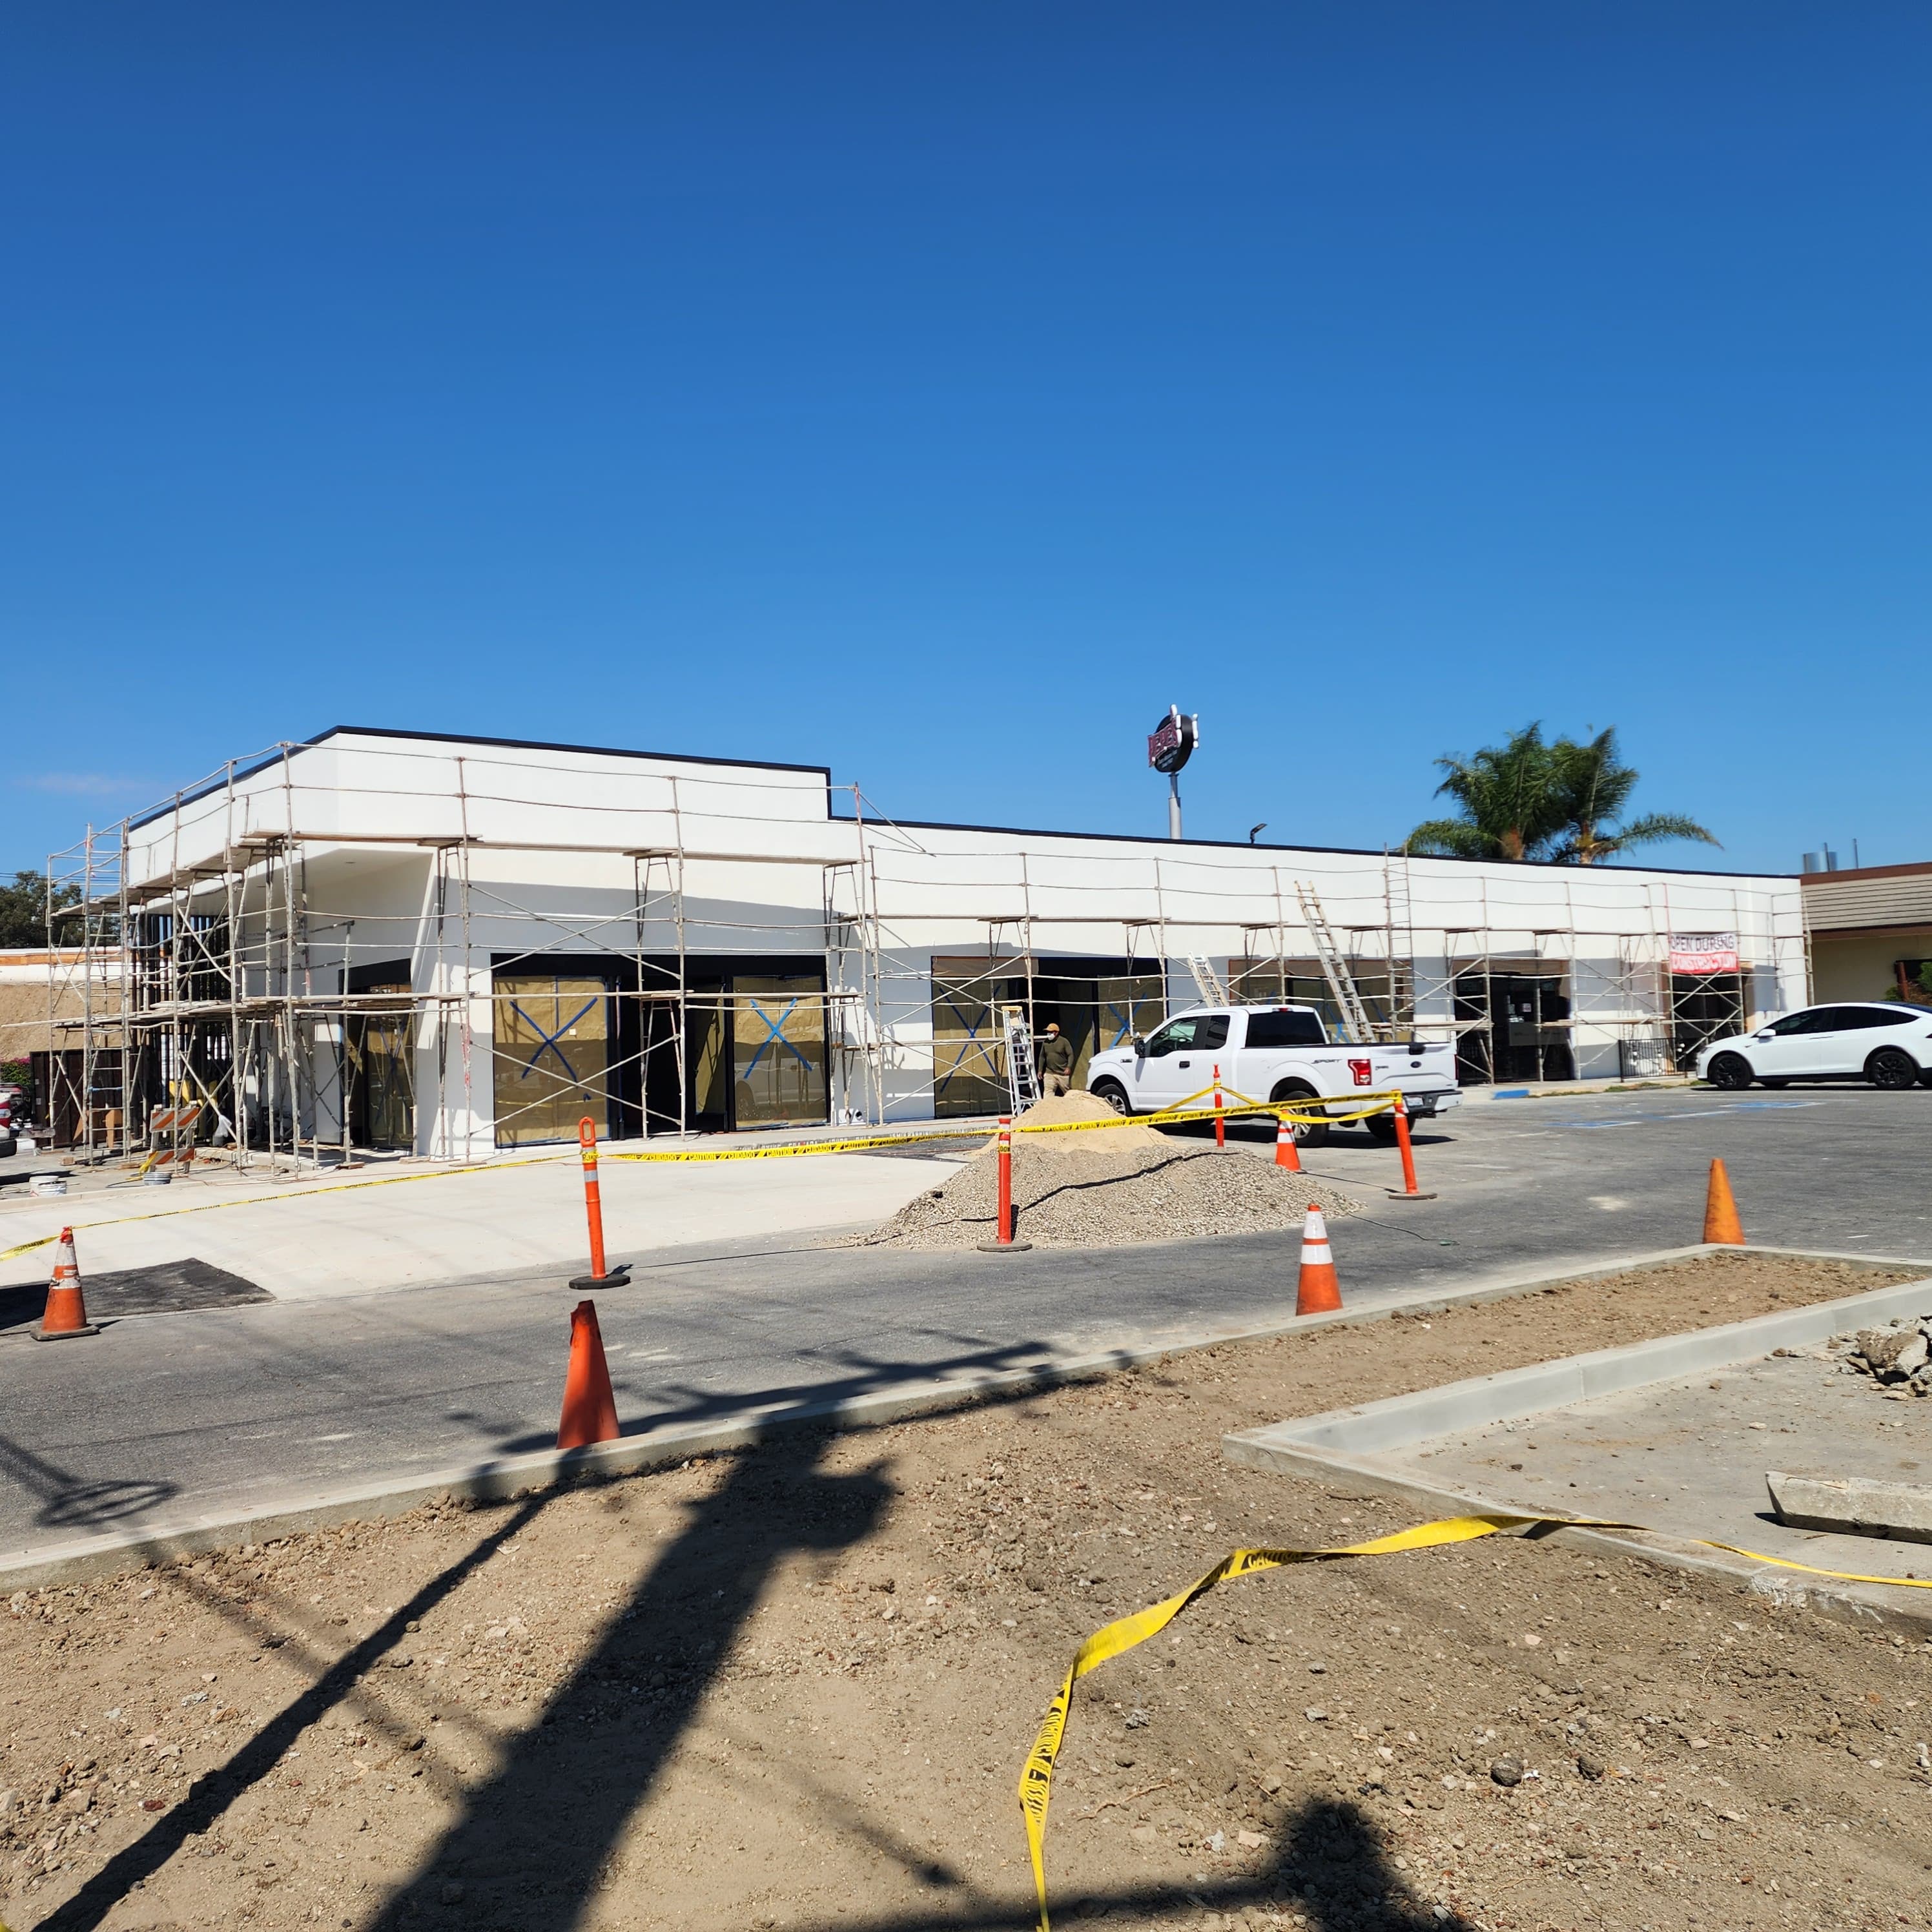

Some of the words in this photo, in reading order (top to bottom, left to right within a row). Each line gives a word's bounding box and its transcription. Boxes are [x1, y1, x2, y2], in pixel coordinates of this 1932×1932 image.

[728, 1151, 755, 1160] CUIDADO
[766, 1148, 794, 1157] CAUTION
[805, 1144, 832, 1154] CUIDADO
[843, 1140, 870, 1150] CAUTION
